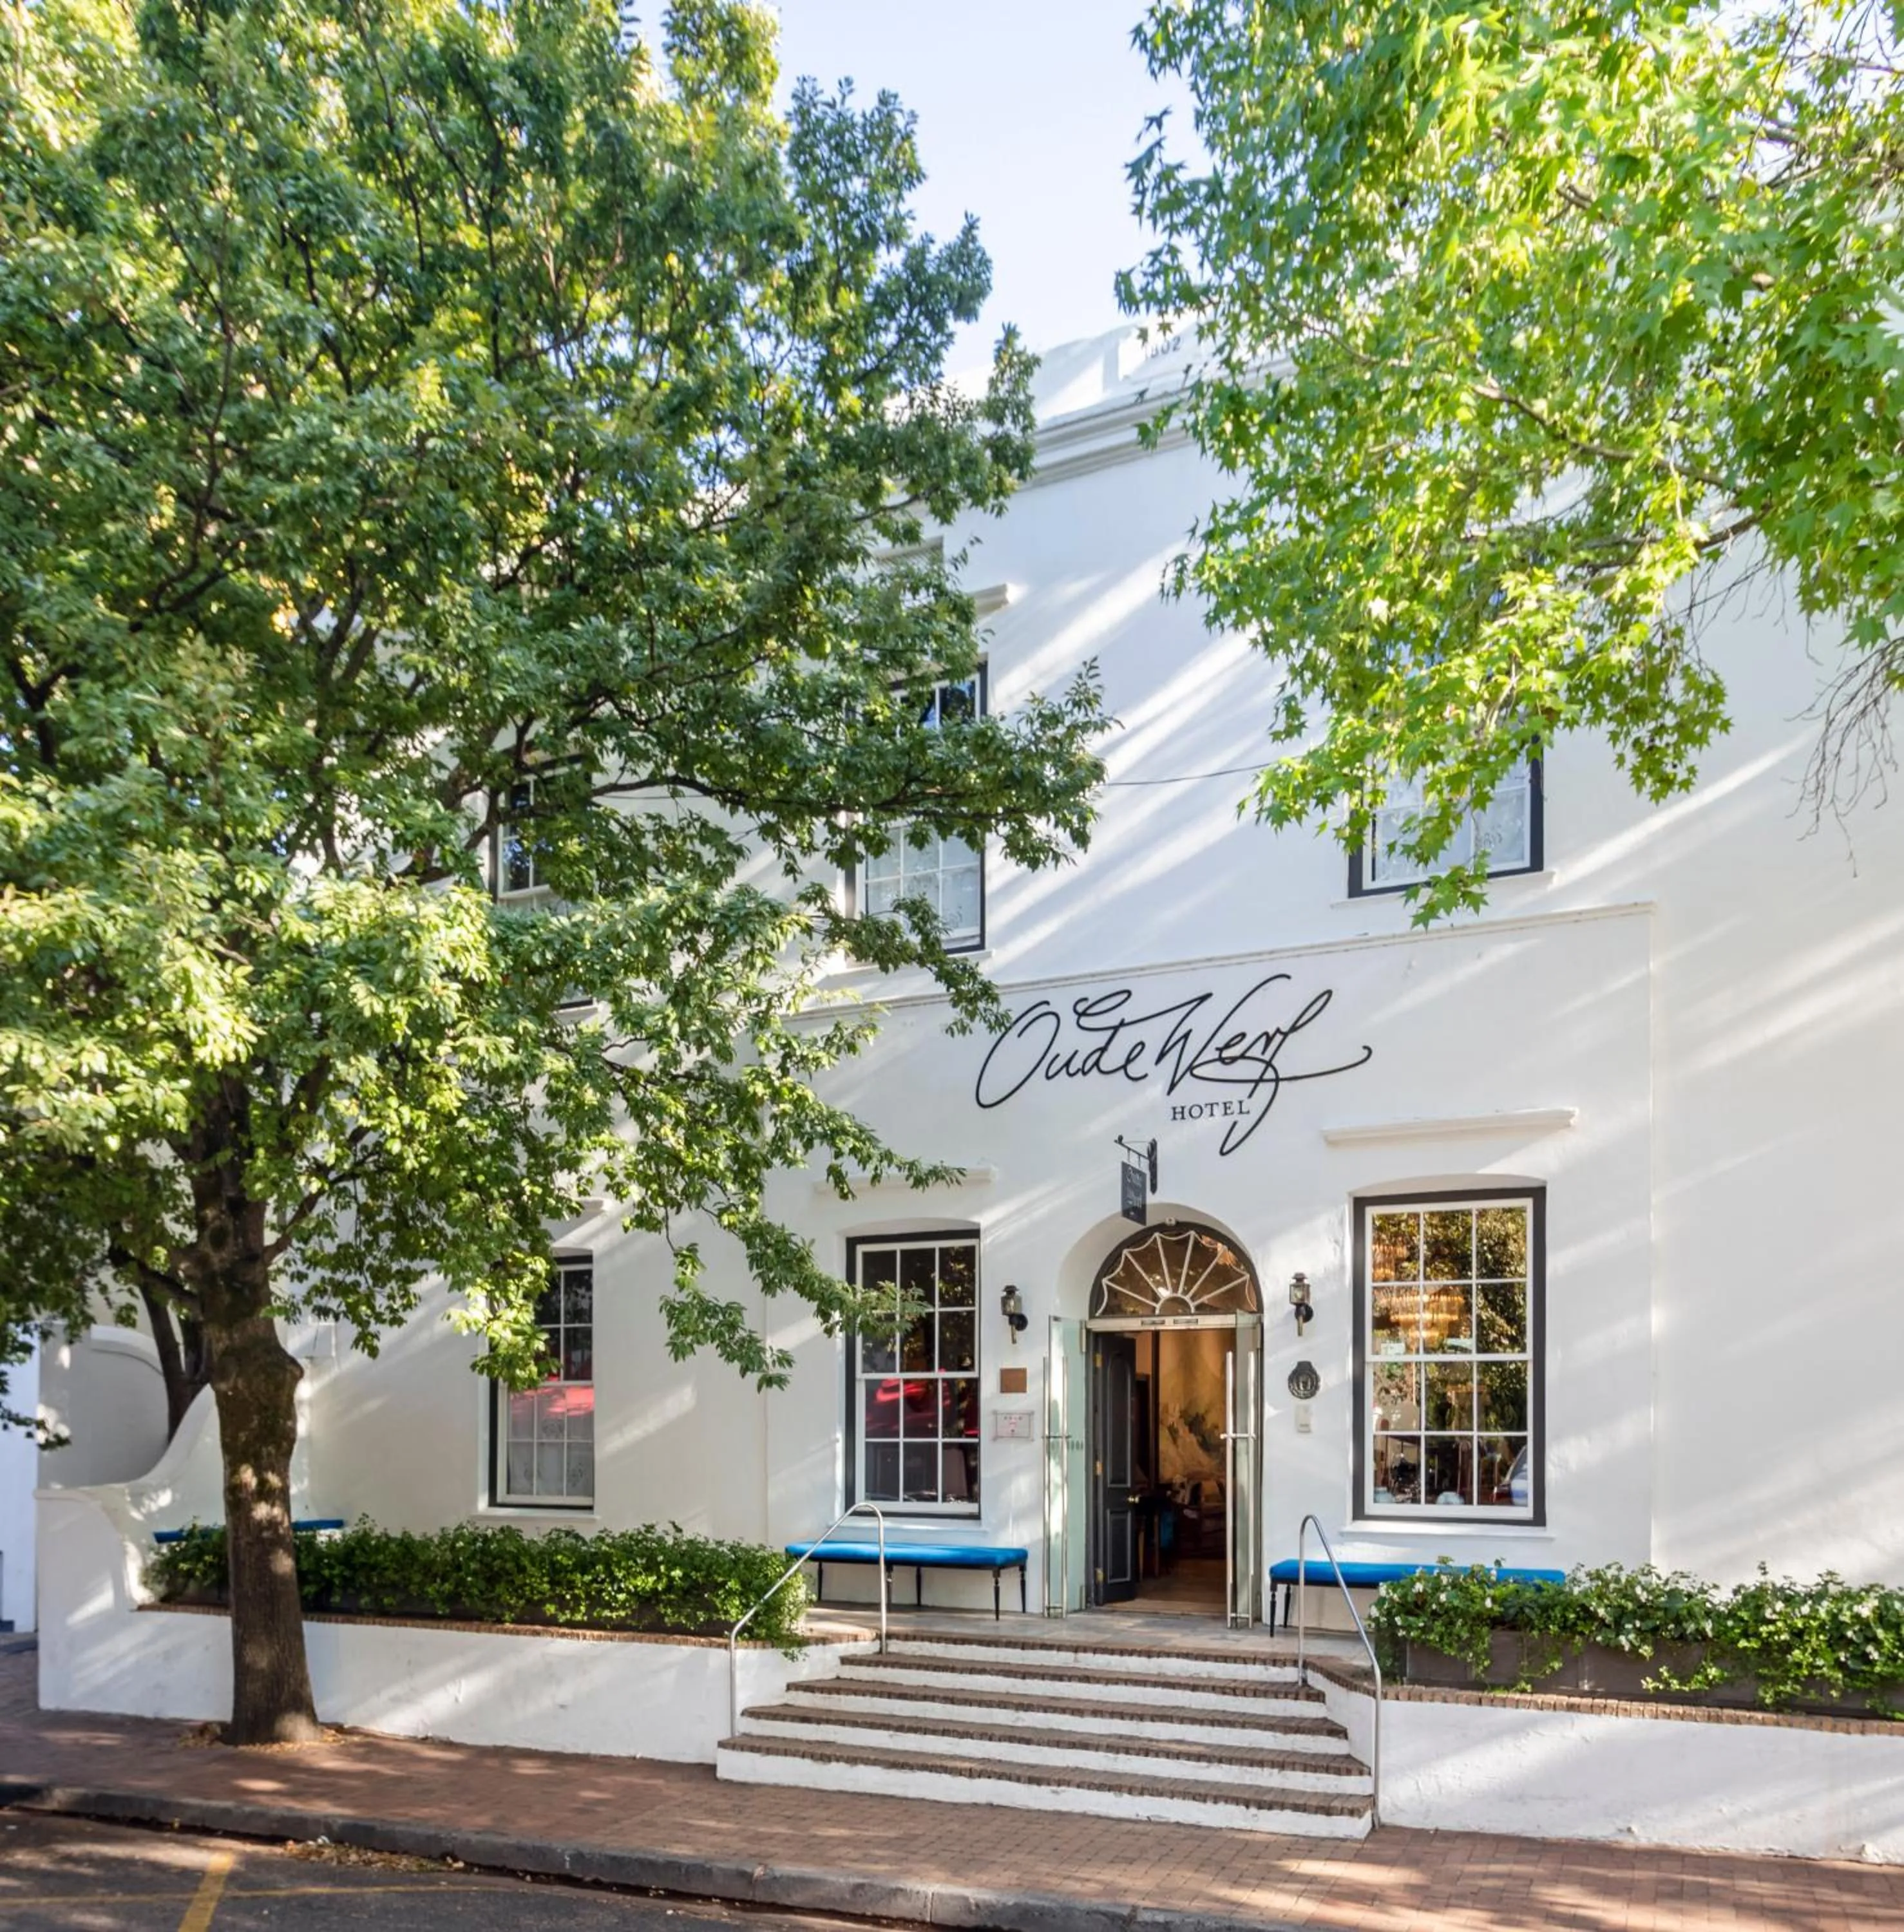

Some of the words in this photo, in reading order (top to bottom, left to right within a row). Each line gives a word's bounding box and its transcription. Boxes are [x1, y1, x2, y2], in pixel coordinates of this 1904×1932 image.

[976, 989, 1148, 1108] Oude
[1155, 974, 1373, 1156] Werf
[1171, 1099, 1251, 1122] HOTEL
